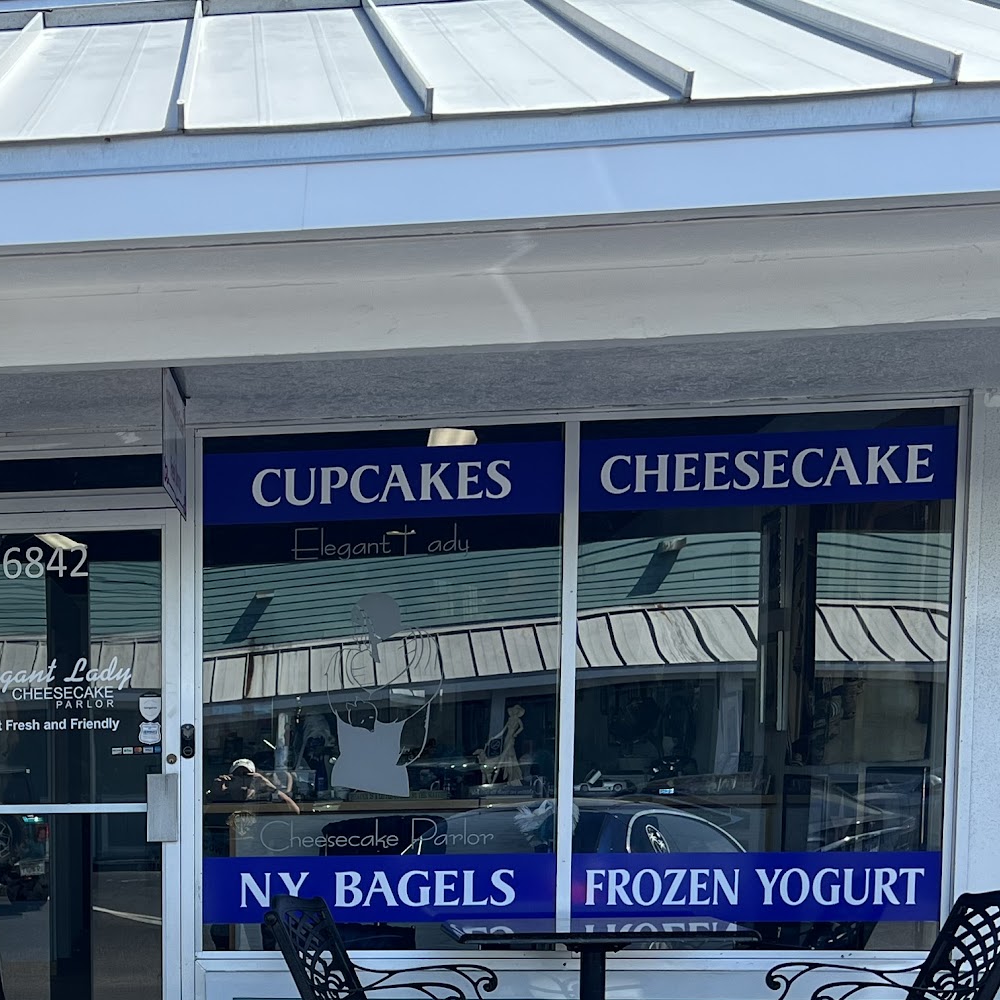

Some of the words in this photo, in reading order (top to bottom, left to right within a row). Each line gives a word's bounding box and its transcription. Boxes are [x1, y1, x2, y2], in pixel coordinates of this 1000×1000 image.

[252, 460, 512, 507] CUPCAKES
[600, 444, 935, 494] CHEESECAKE
[291, 527, 392, 561] Elegant
[2, 546, 89, 579] 6842
[63, 656, 132, 690] Lady
[11, 686, 114, 701] CHEESECAKE
[56, 699, 114, 710] PARLOR
[5, 719, 40, 731] Fresh
[43, 718, 67, 730] and
[70, 717, 120, 731] Friendly
[259, 818, 399, 852] Cheesecake
[411, 818, 494, 849] Parlor
[239, 872, 310, 908] NY
[334, 869, 516, 908] BAGELS
[585, 868, 740, 906] FROZEN
[755, 867, 925, 906] YOGURT
